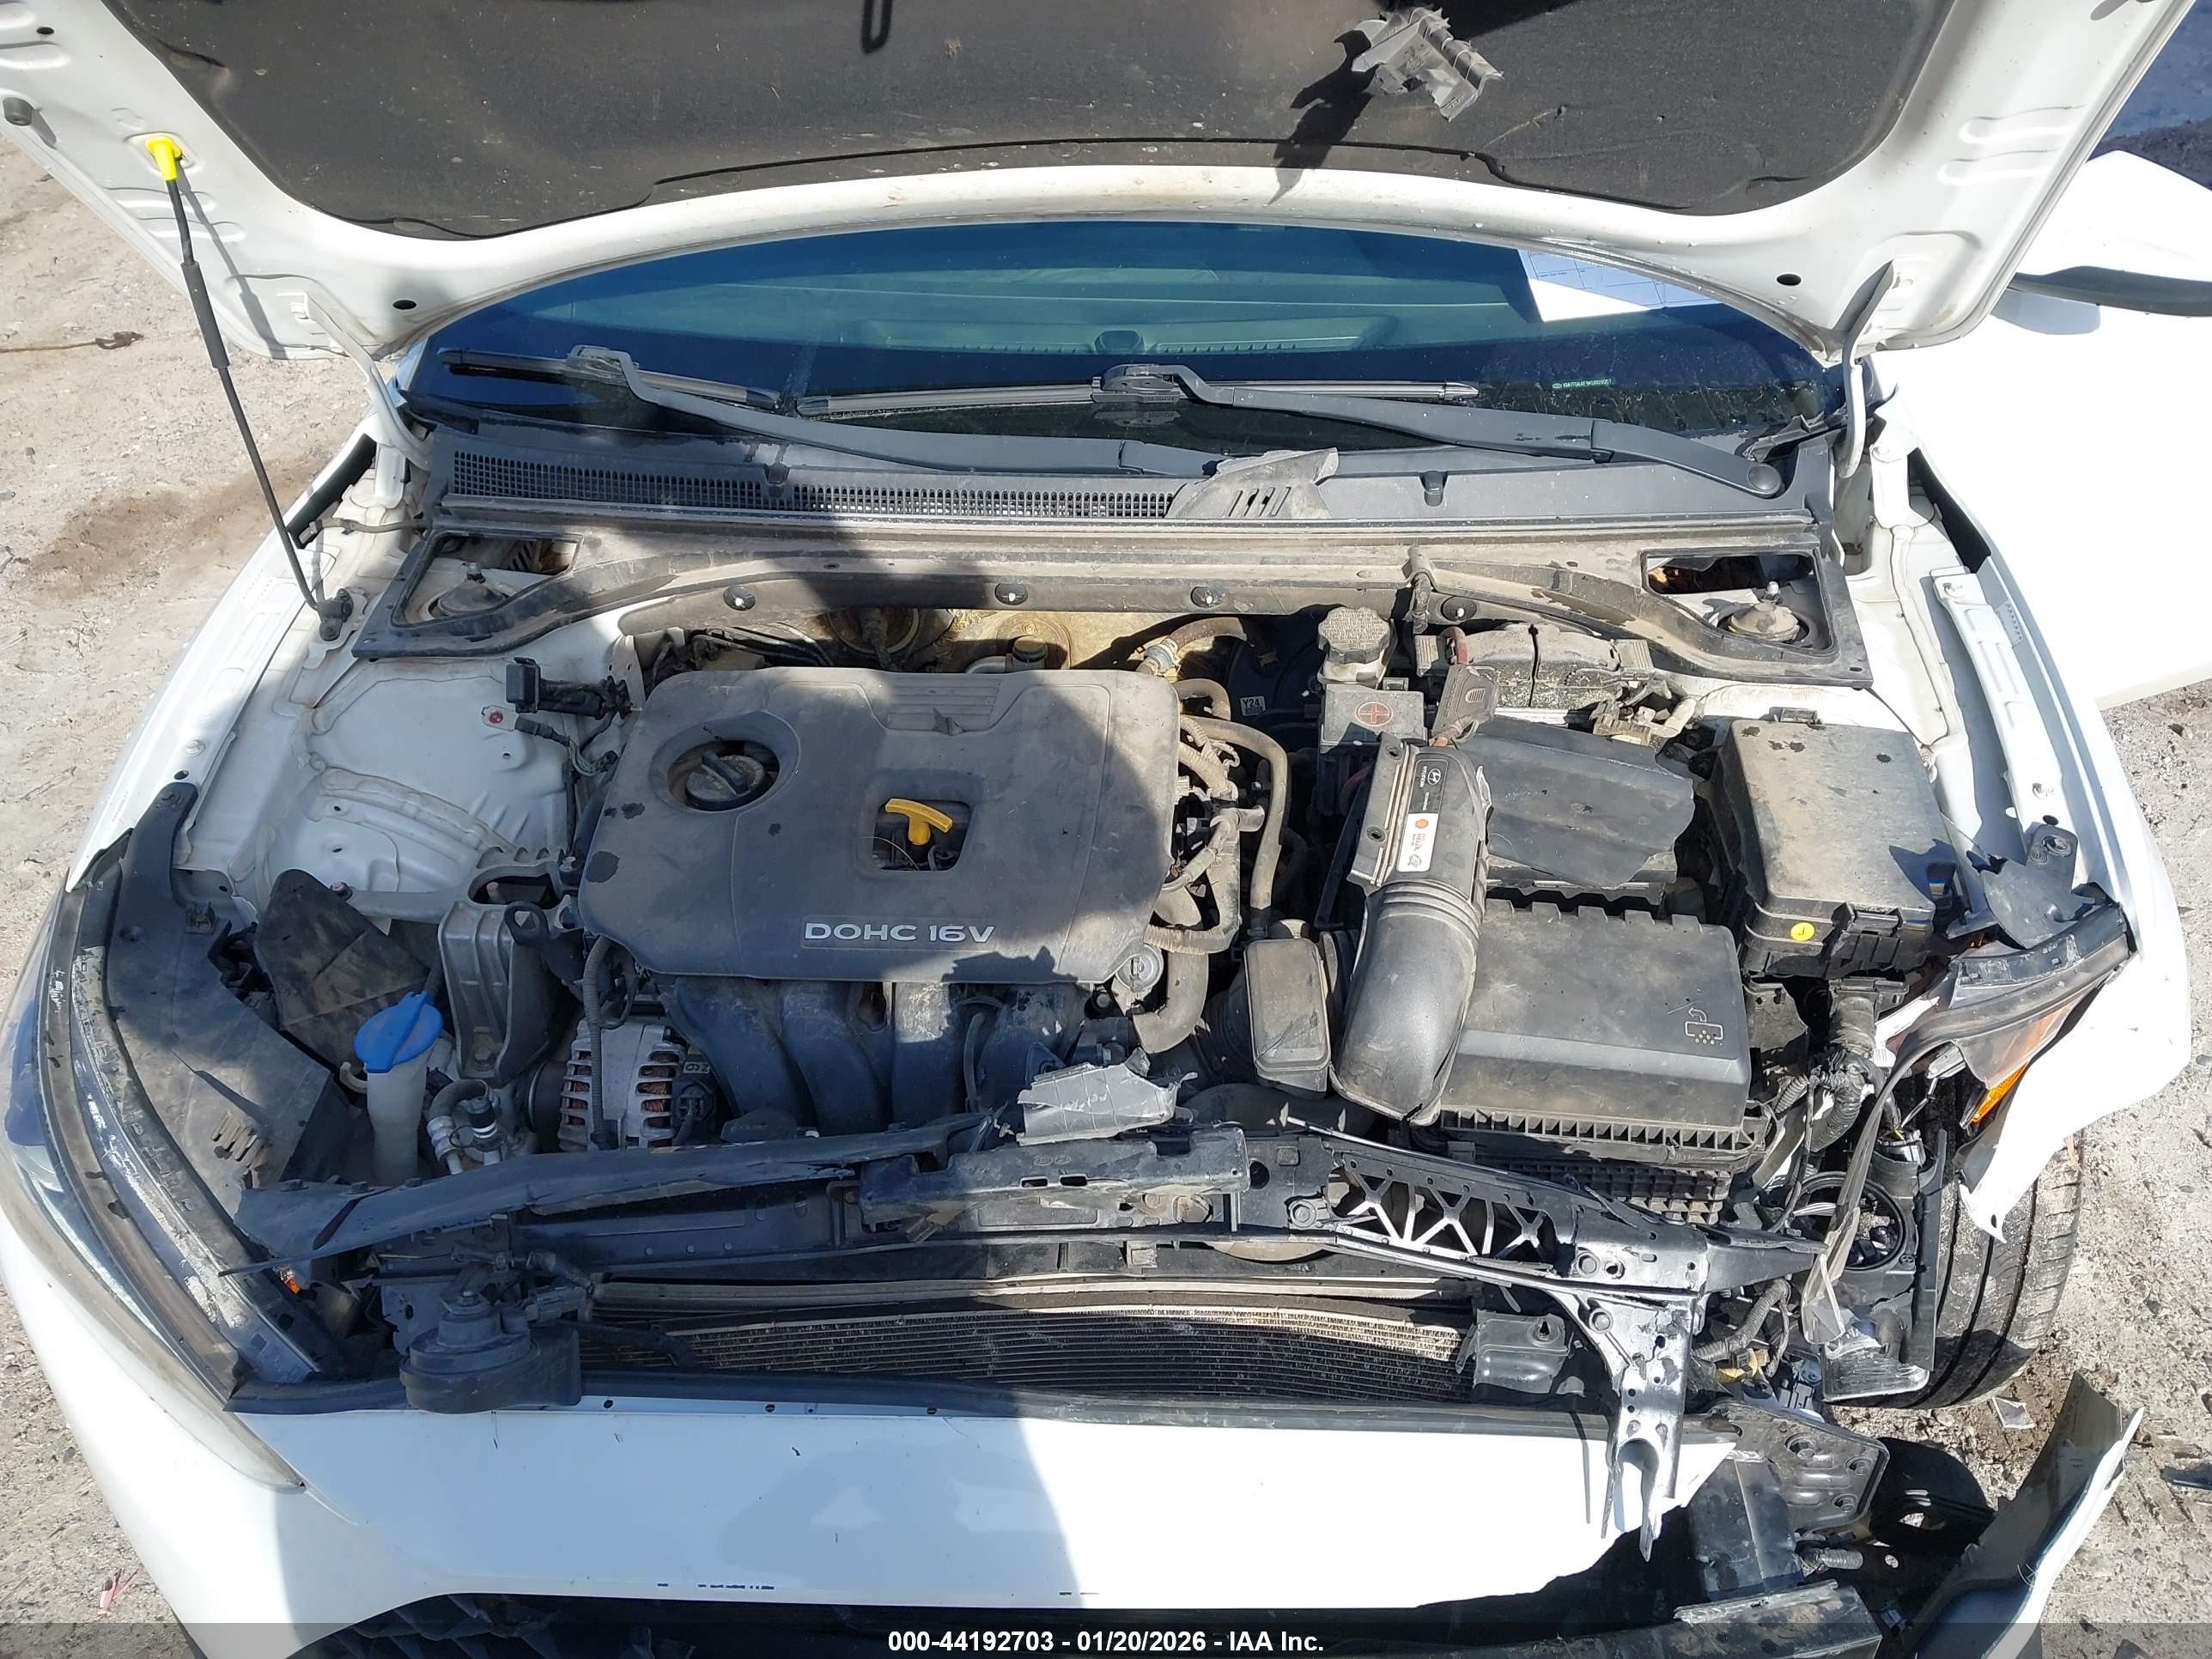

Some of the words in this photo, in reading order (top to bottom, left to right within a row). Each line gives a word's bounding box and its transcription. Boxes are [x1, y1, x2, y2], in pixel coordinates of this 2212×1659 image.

[1242, 697, 1261, 708] Y24
[805, 922, 917, 941] DOHC
[929, 925, 995, 943] 16V
